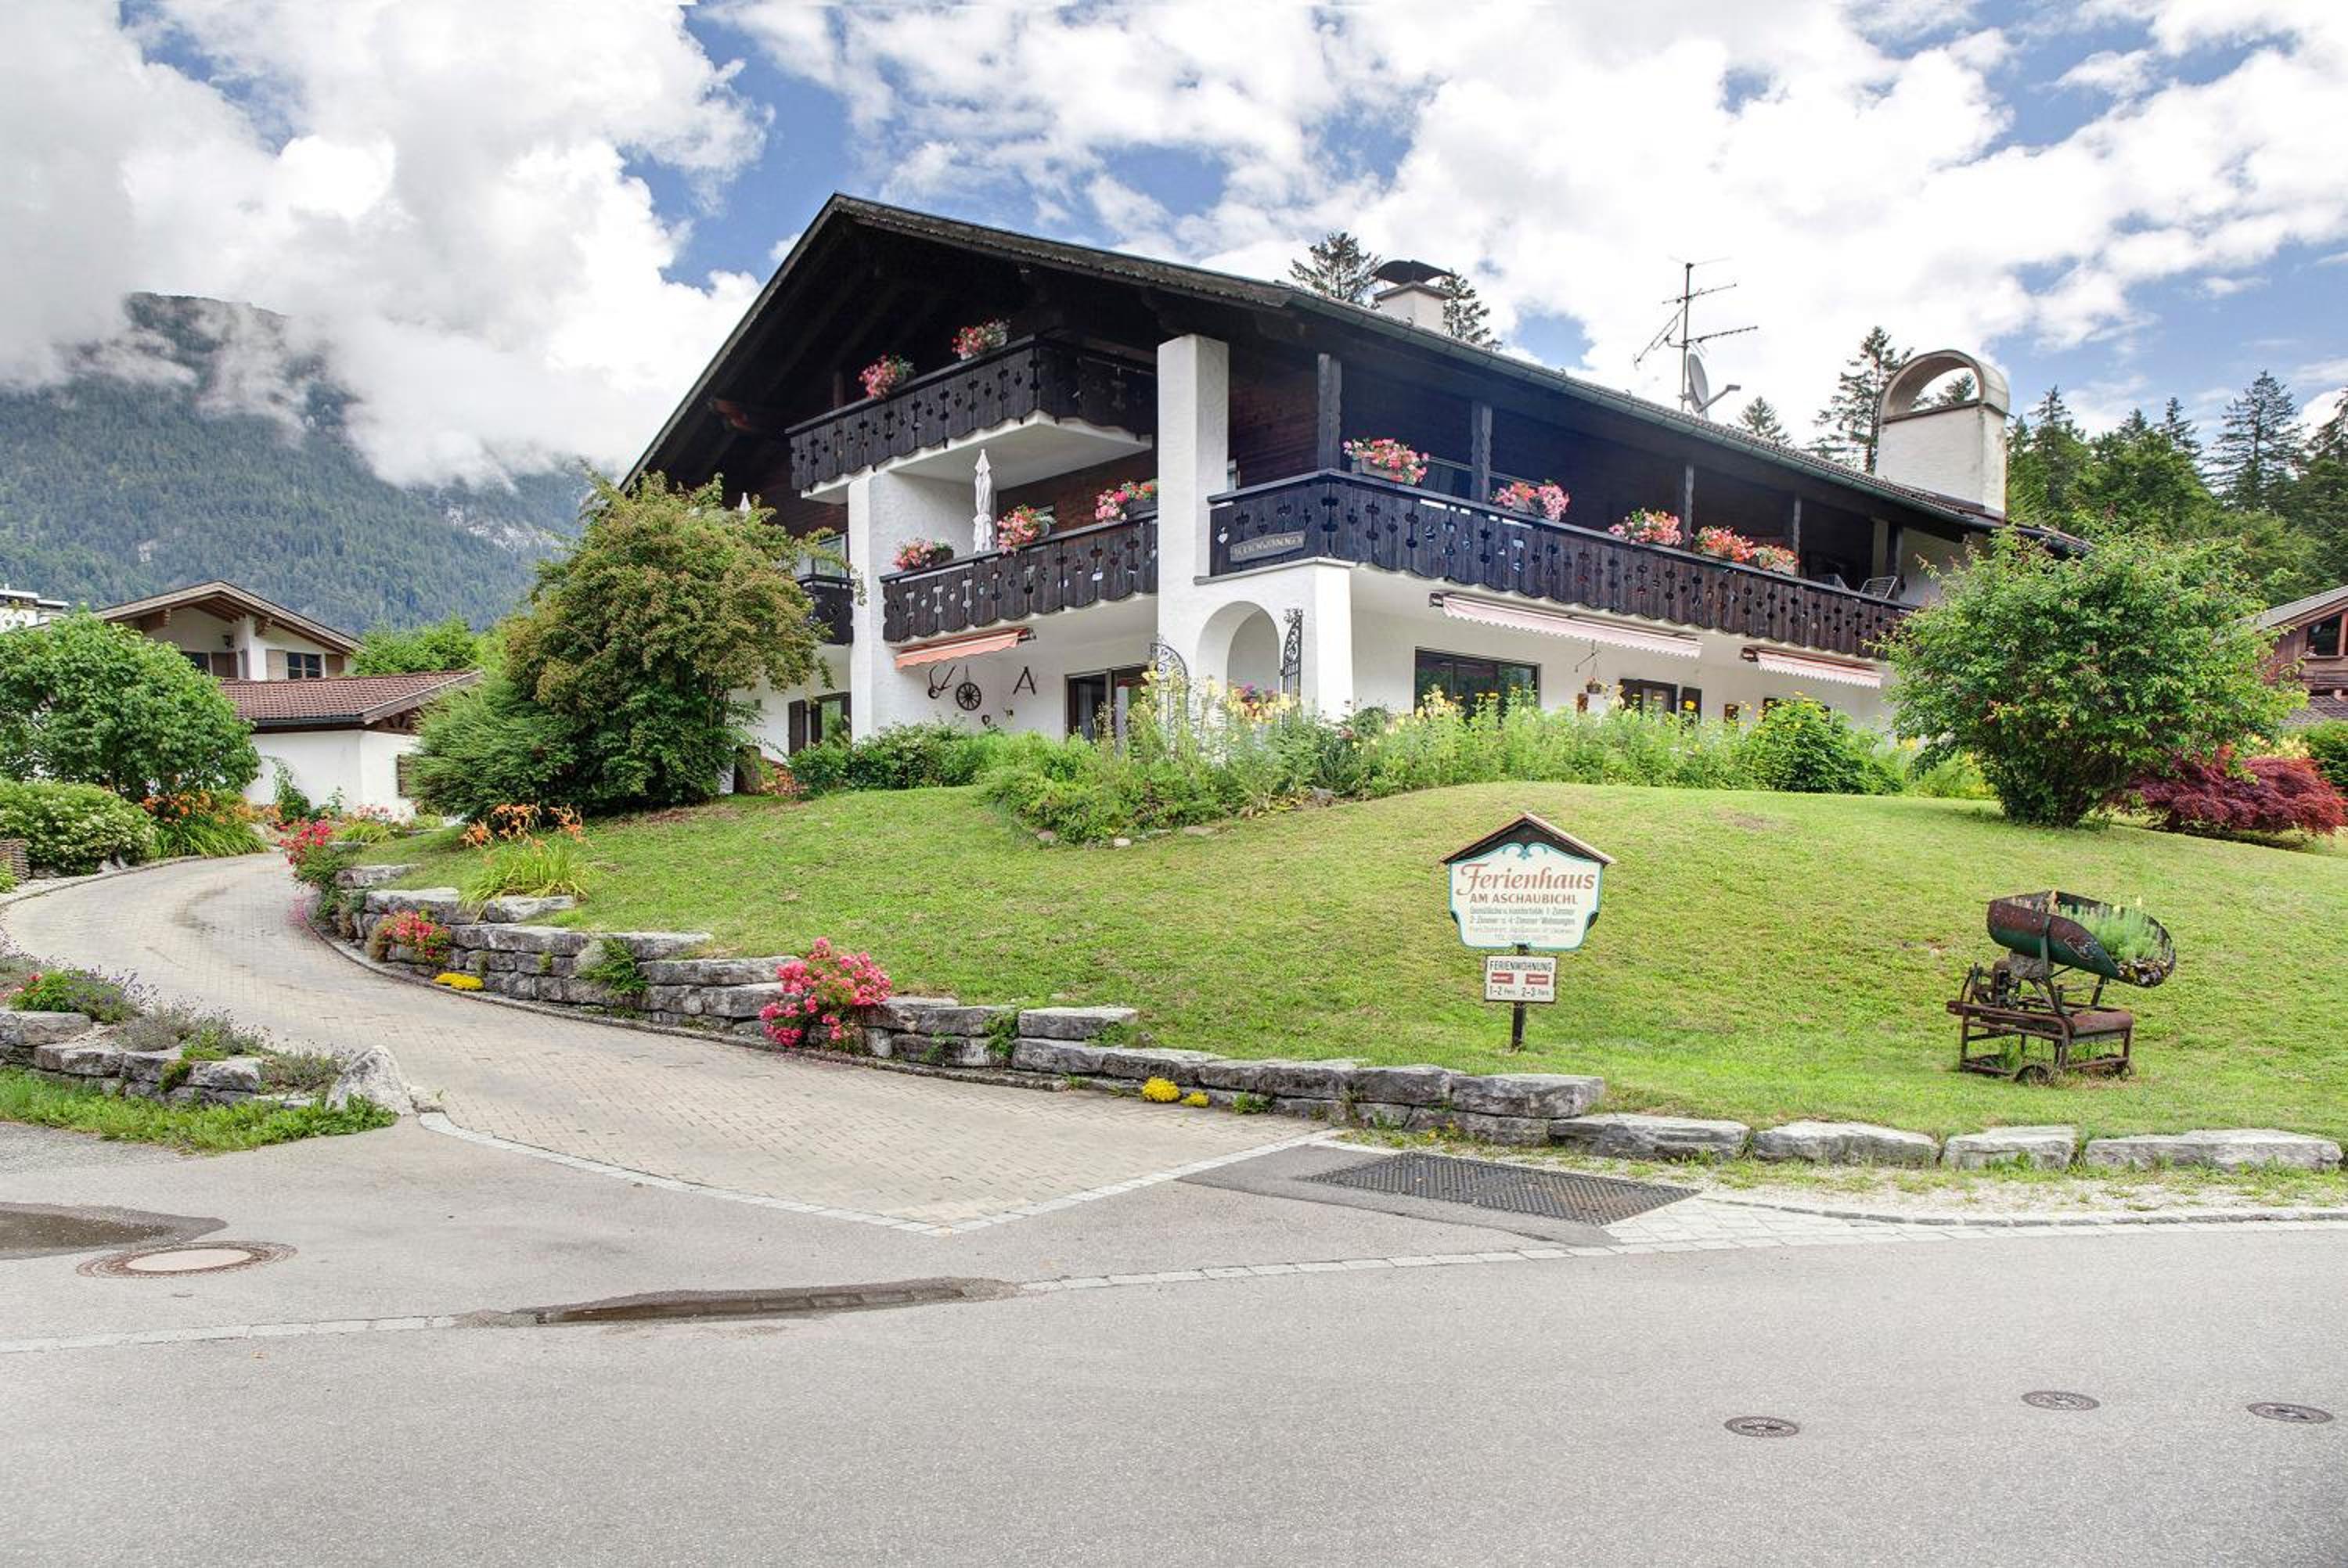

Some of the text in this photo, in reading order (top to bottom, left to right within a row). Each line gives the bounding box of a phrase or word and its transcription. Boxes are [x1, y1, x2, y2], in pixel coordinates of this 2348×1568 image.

[1456, 863, 1595, 896] Ferienhaus
[1469, 893, 1578, 905] AM ASCHAUBICHL
[1489, 960, 1553, 972] FERIENWOHNUNG
